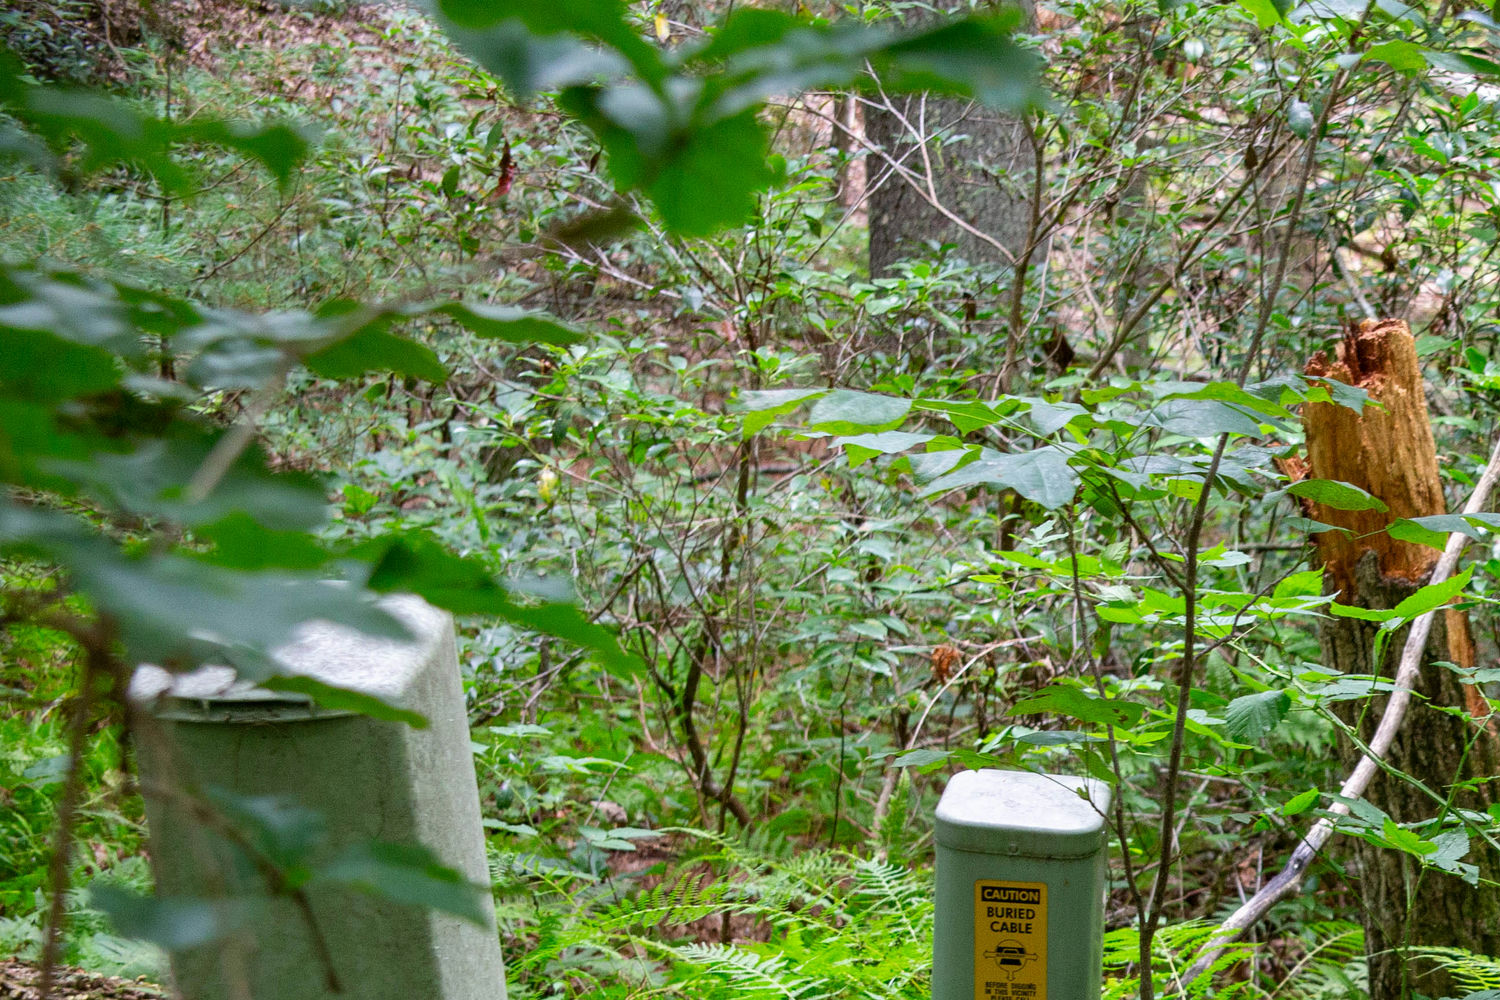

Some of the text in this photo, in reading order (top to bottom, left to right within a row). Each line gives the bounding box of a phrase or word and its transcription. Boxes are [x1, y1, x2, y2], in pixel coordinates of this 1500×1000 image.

[983, 888, 1039, 901] CAUTION
[986, 906, 1036, 920] BURIED
[990, 921, 1033, 934] CABLE
